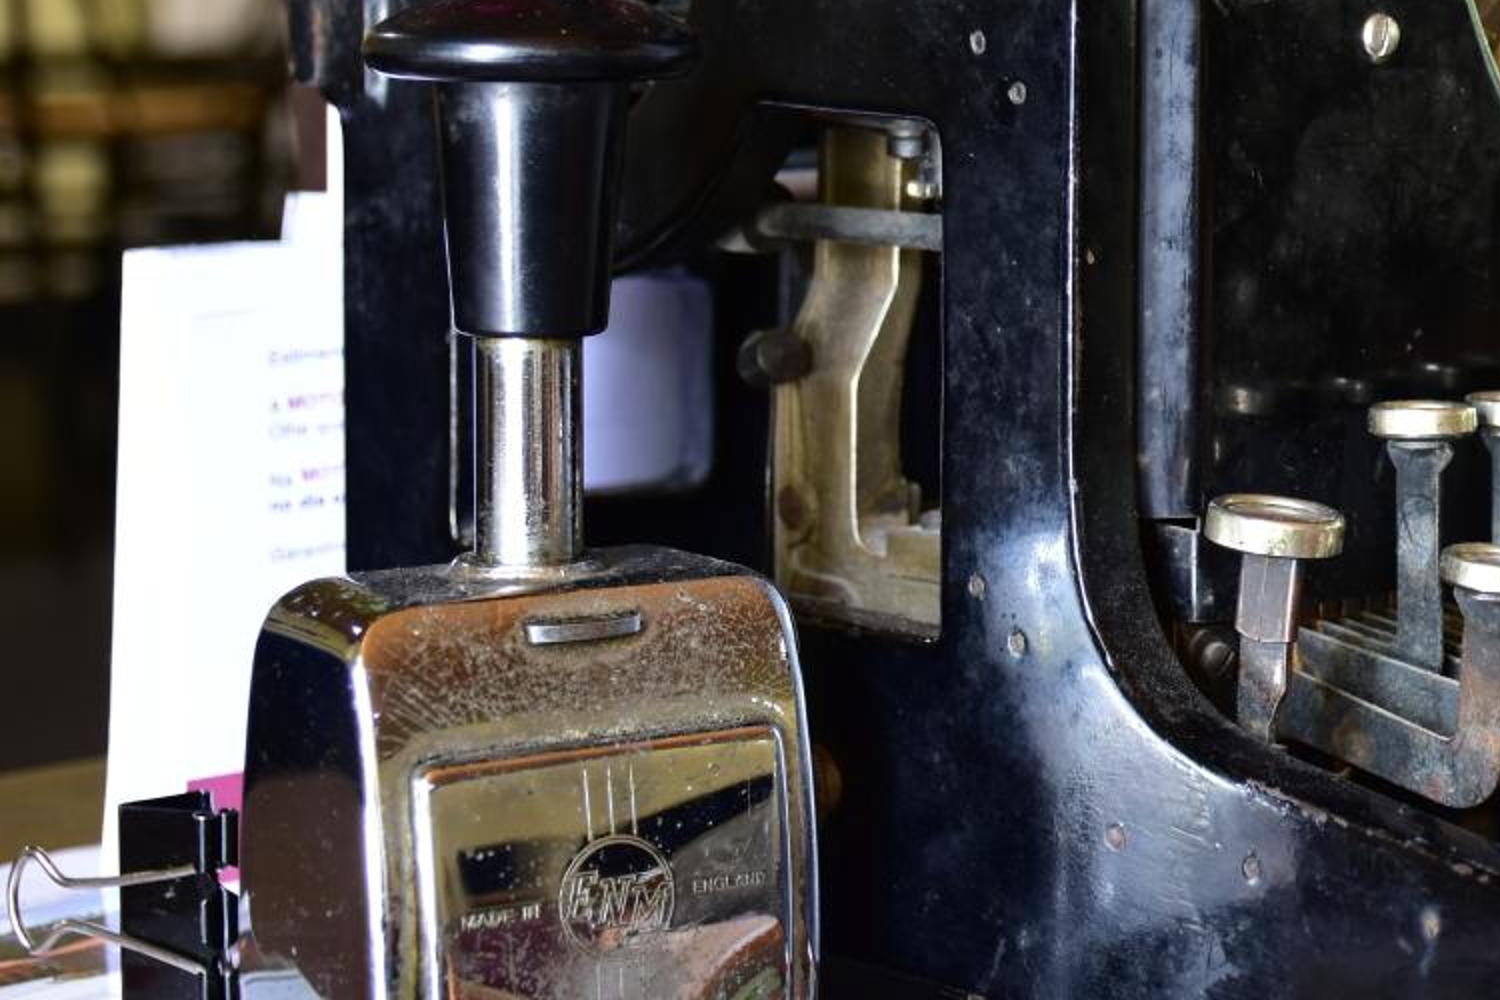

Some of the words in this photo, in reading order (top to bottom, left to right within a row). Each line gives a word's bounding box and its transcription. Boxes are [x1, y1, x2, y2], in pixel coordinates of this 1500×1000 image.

[461, 906, 514, 934] MADE
[522, 903, 541, 921] IN
[692, 871, 767, 897] ENGLAND
[568, 869, 675, 931] ENM
